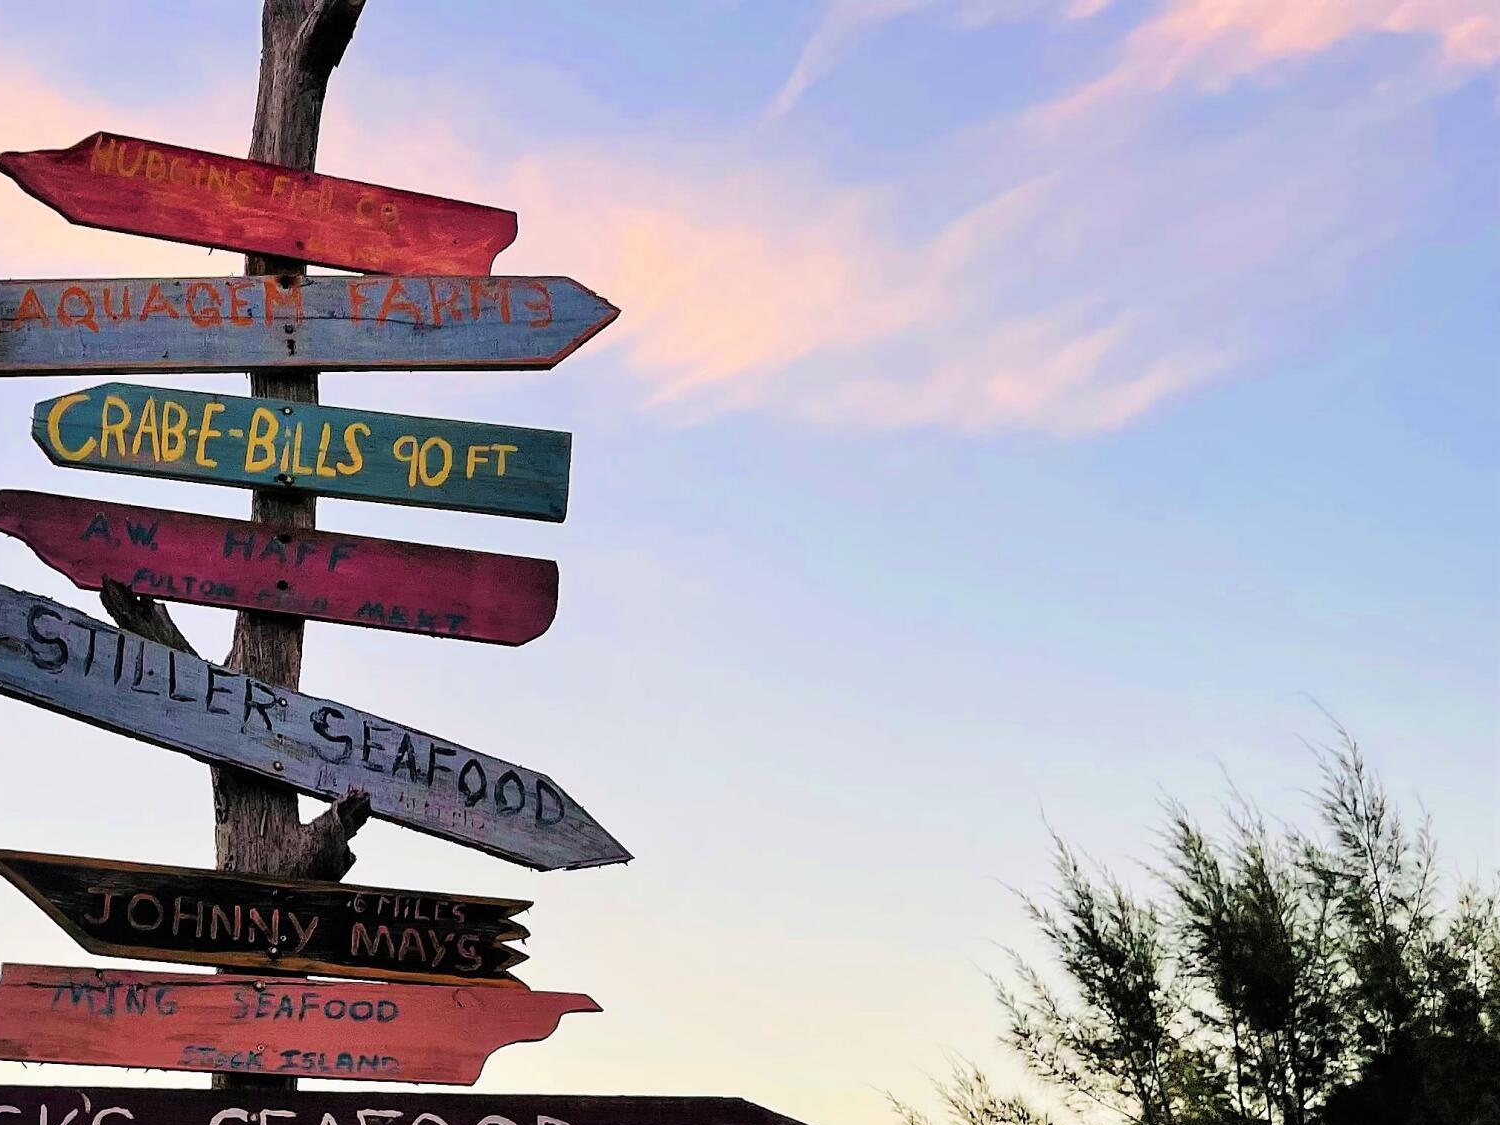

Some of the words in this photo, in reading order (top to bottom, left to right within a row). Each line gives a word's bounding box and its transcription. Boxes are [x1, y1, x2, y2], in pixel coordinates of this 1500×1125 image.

[393, 435, 453, 487] 90
[467, 443, 519, 478] FT
[223, 525, 360, 571] HAFF
[26, 604, 274, 732] STILLER
[311, 706, 566, 828] SEAFOOD
[85, 886, 321, 951] JOHNNY
[232, 991, 401, 1023] SEAFOOD
